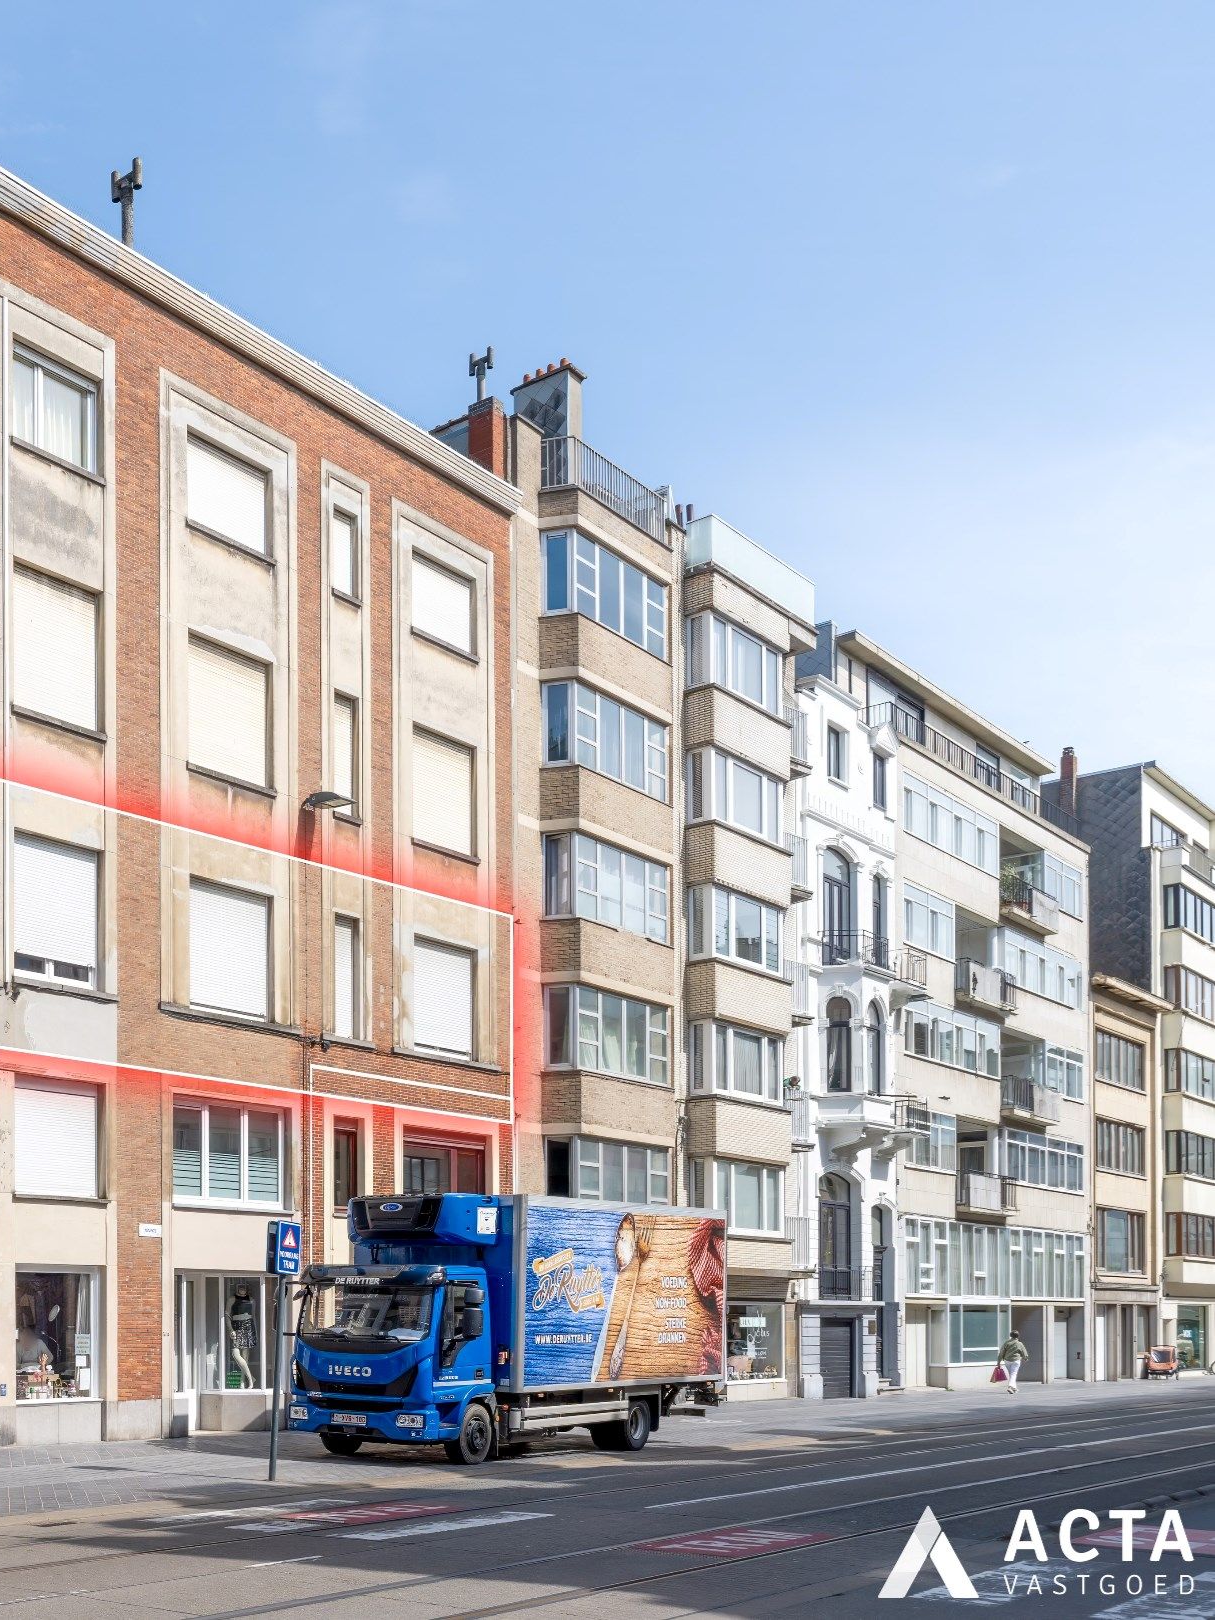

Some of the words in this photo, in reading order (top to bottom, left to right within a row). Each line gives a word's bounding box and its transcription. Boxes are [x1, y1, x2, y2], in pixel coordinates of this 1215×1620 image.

[335, 1277, 345, 1285] DE
[346, 1277, 380, 1285] RUYTTER
[329, 1364, 372, 1377] IVECO
